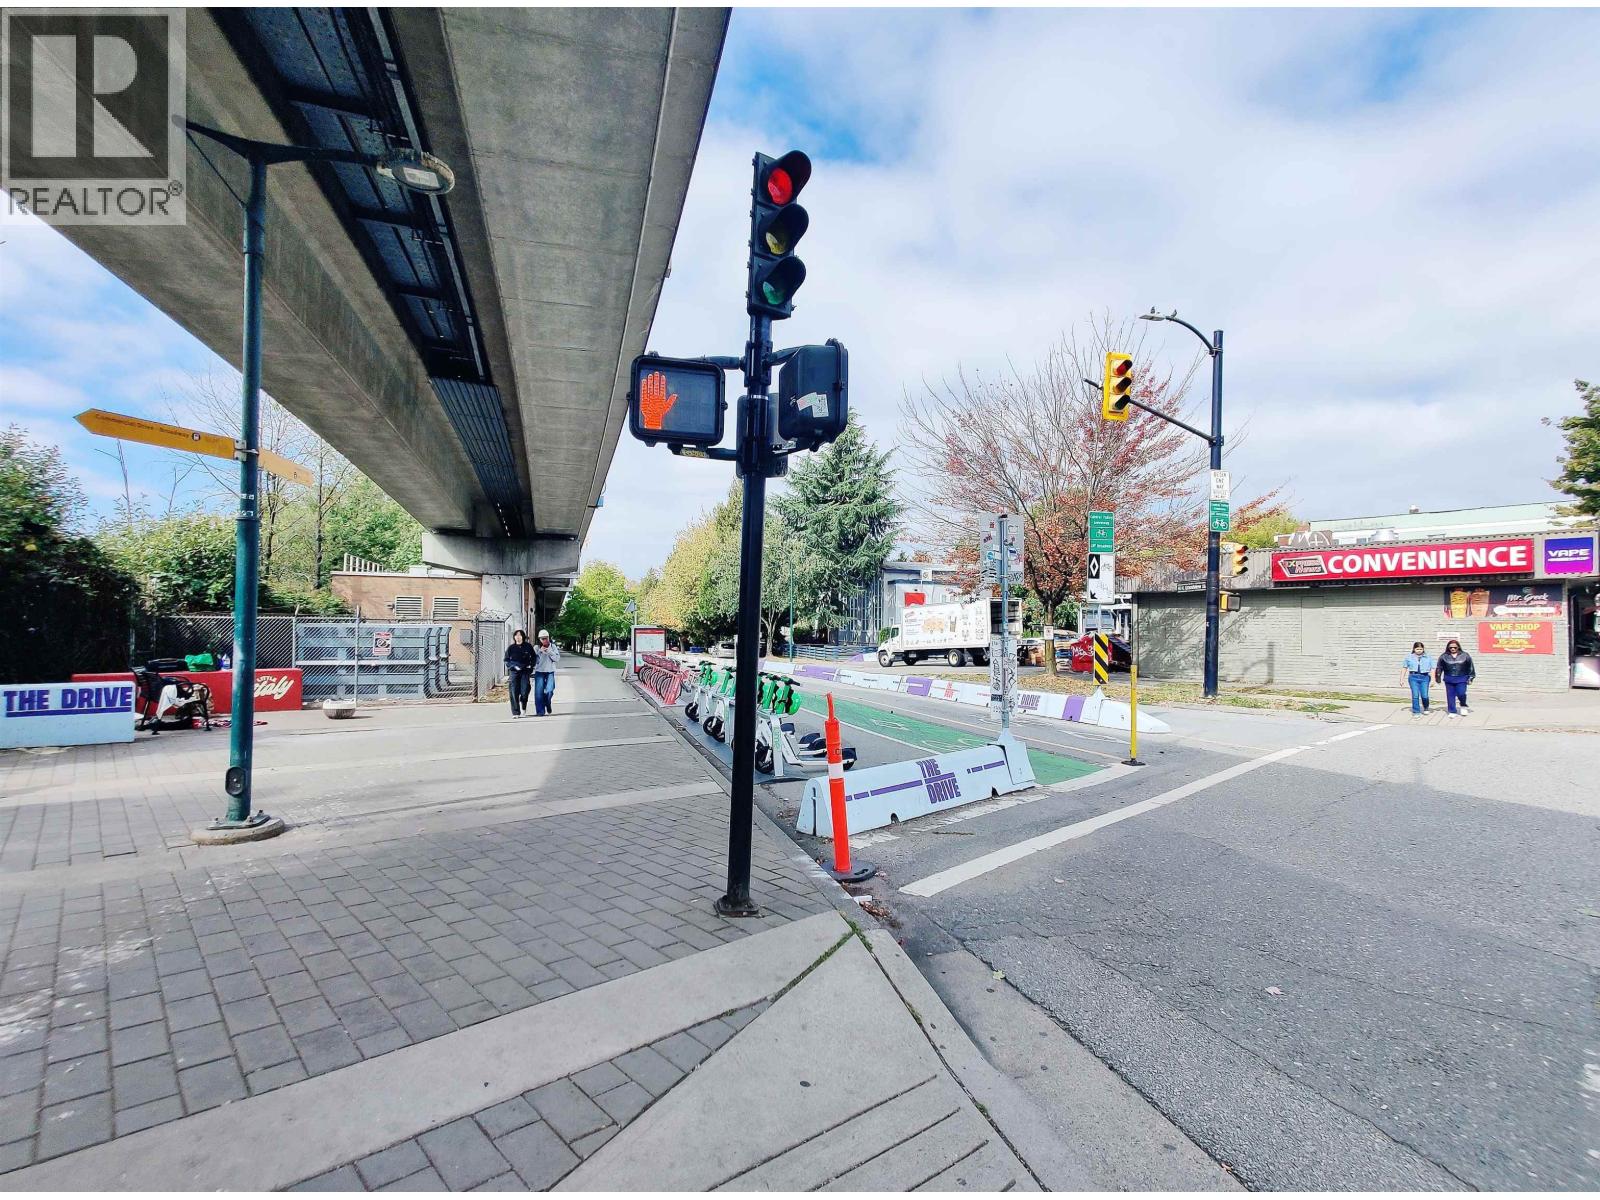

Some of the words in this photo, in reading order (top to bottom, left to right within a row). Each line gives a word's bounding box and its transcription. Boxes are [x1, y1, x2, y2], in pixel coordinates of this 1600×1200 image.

[1328, 545, 1527, 574] CONVENIENCE
[1547, 548, 1590, 557] VAPE
[1507, 594, 1521, 602] Mr.
[1524, 592, 1549, 602] Greek
[1489, 623, 1513, 631] VAPE
[1515, 623, 1541, 631] SHOP
[3, 689, 49, 712] THE
[61, 686, 133, 709] DRIVE
[915, 758, 941, 779] THE
[926, 777, 962, 804] DRIVE
